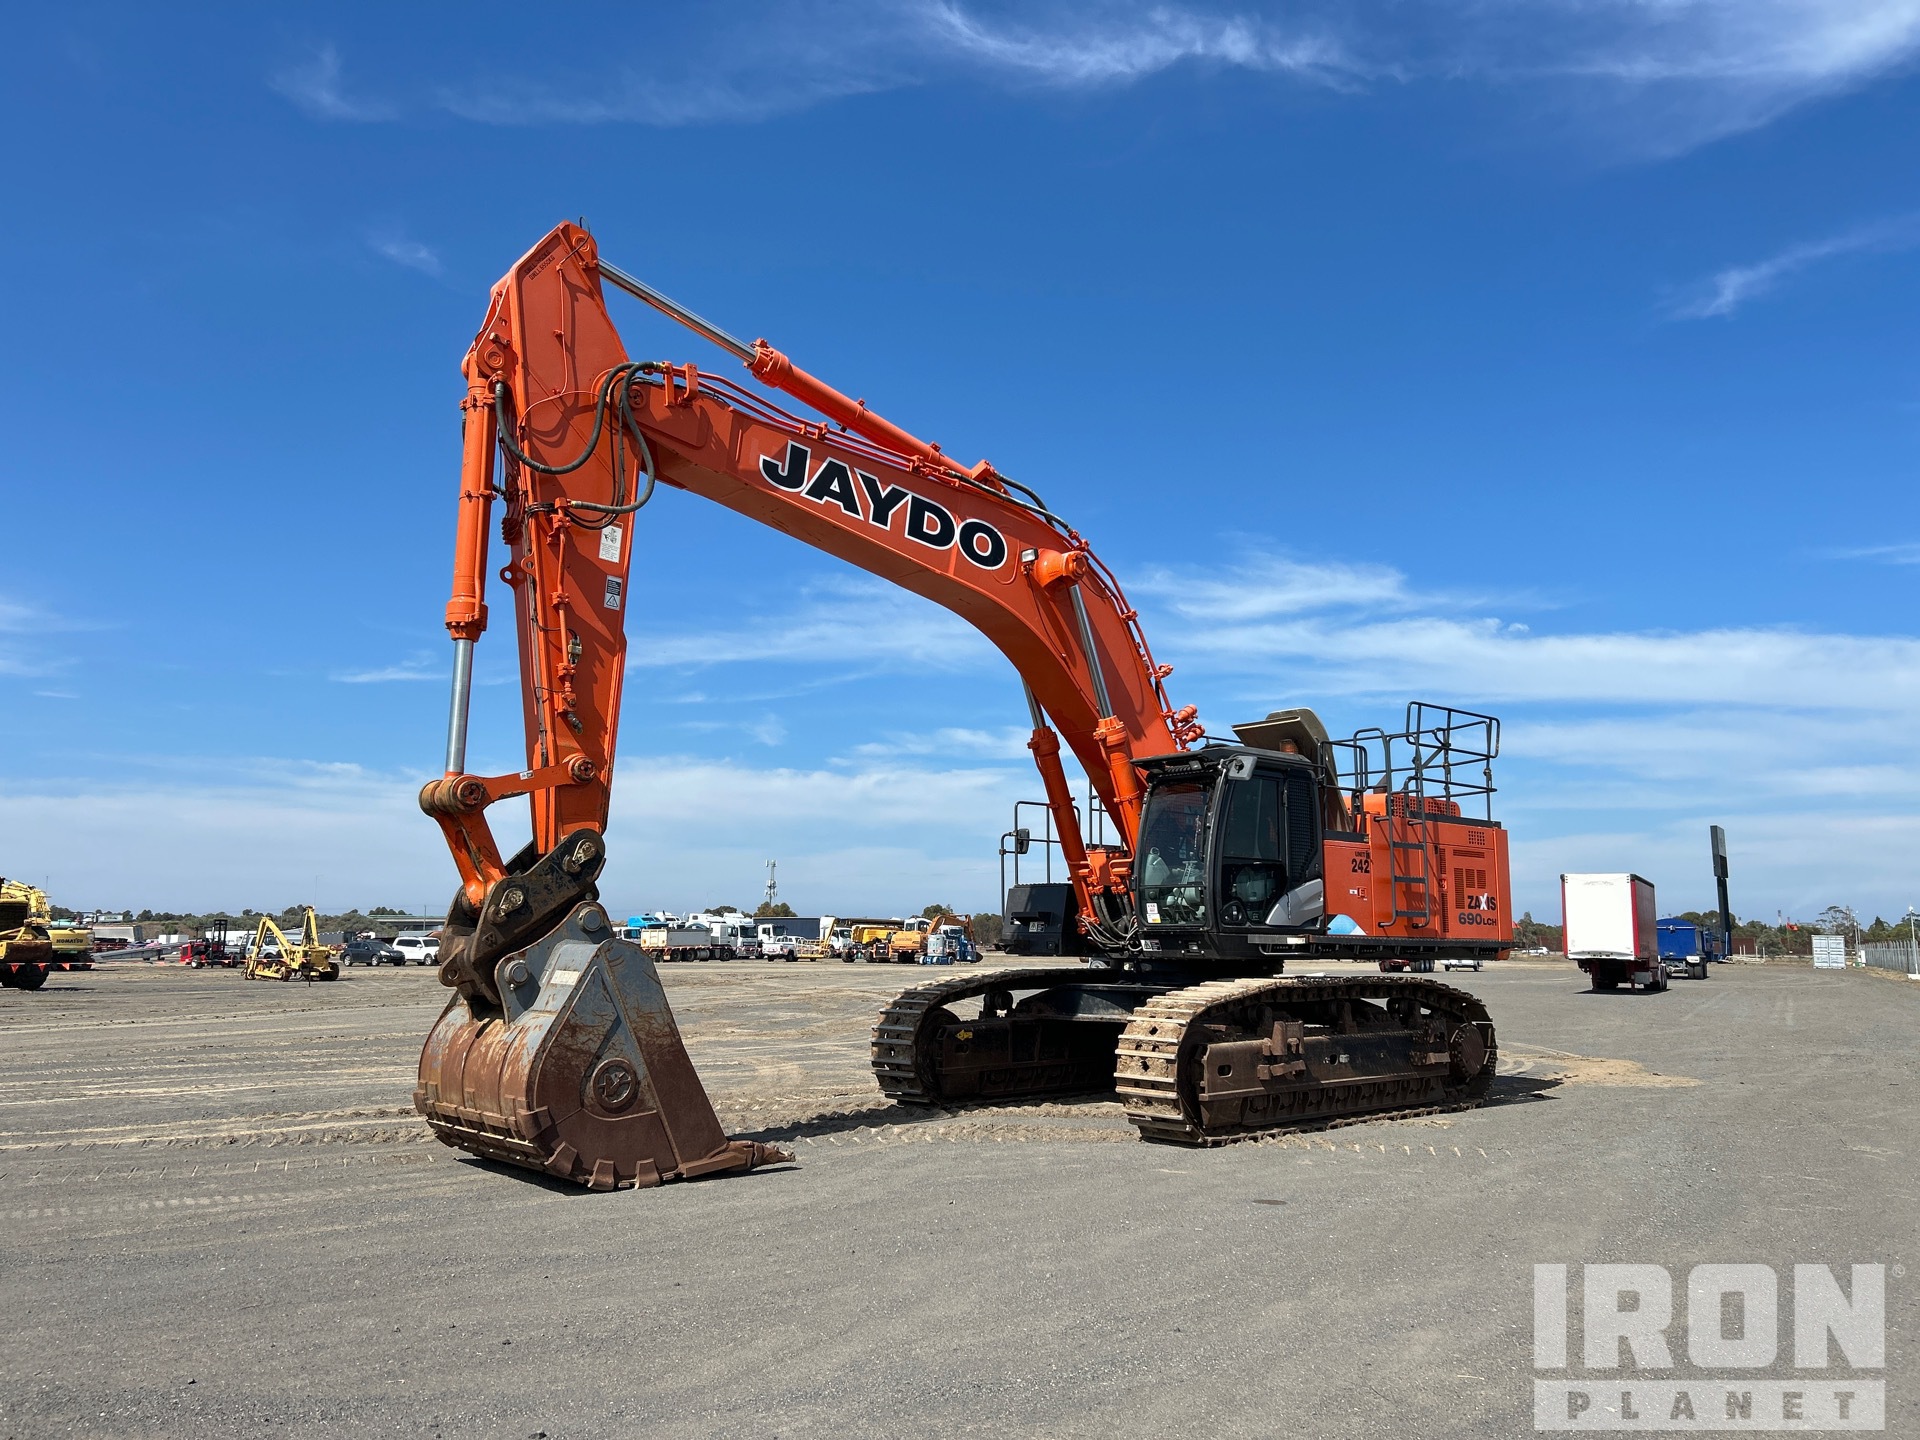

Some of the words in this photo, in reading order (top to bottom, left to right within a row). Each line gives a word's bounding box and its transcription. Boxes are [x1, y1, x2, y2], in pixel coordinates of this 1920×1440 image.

[759, 440, 1008, 570] JAYDO
[1351, 858, 1370, 873] 242
[1467, 892, 1497, 911] ZAXIS
